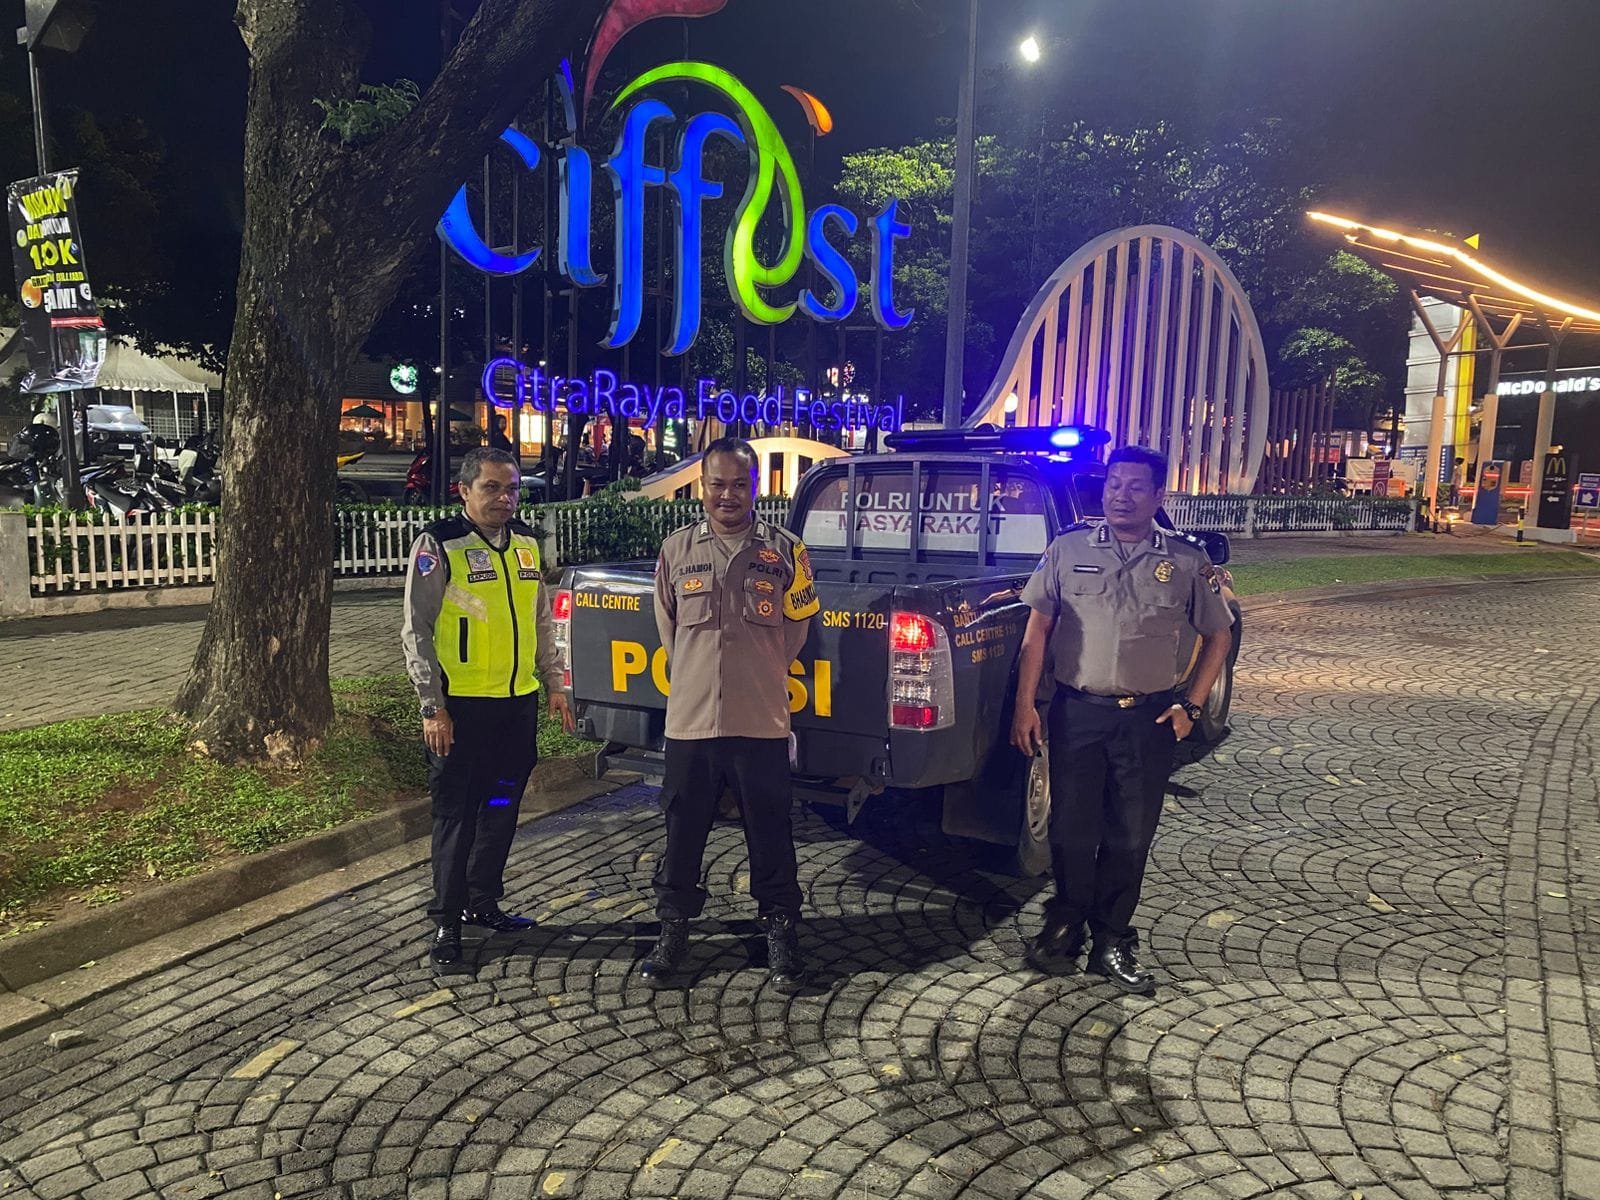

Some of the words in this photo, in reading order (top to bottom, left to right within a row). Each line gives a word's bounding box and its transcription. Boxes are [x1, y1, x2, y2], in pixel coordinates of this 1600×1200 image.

[481, 357, 685, 429] CitraRaya
[698, 379, 783, 427] Food
[793, 389, 904, 431] Festival
[841, 491, 911, 511] POLRI
[919, 493, 1006, 512] UNTUK
[748, 562, 783, 578] POLRI
[575, 592, 600, 608] CALL
[601, 594, 641, 612] CENTRE
[822, 611, 850, 627] SMS
[854, 612, 885, 630] 1120
[955, 631, 975, 648] CALL
[971, 647, 987, 664] SMS
[611, 640, 831, 718] PSI
